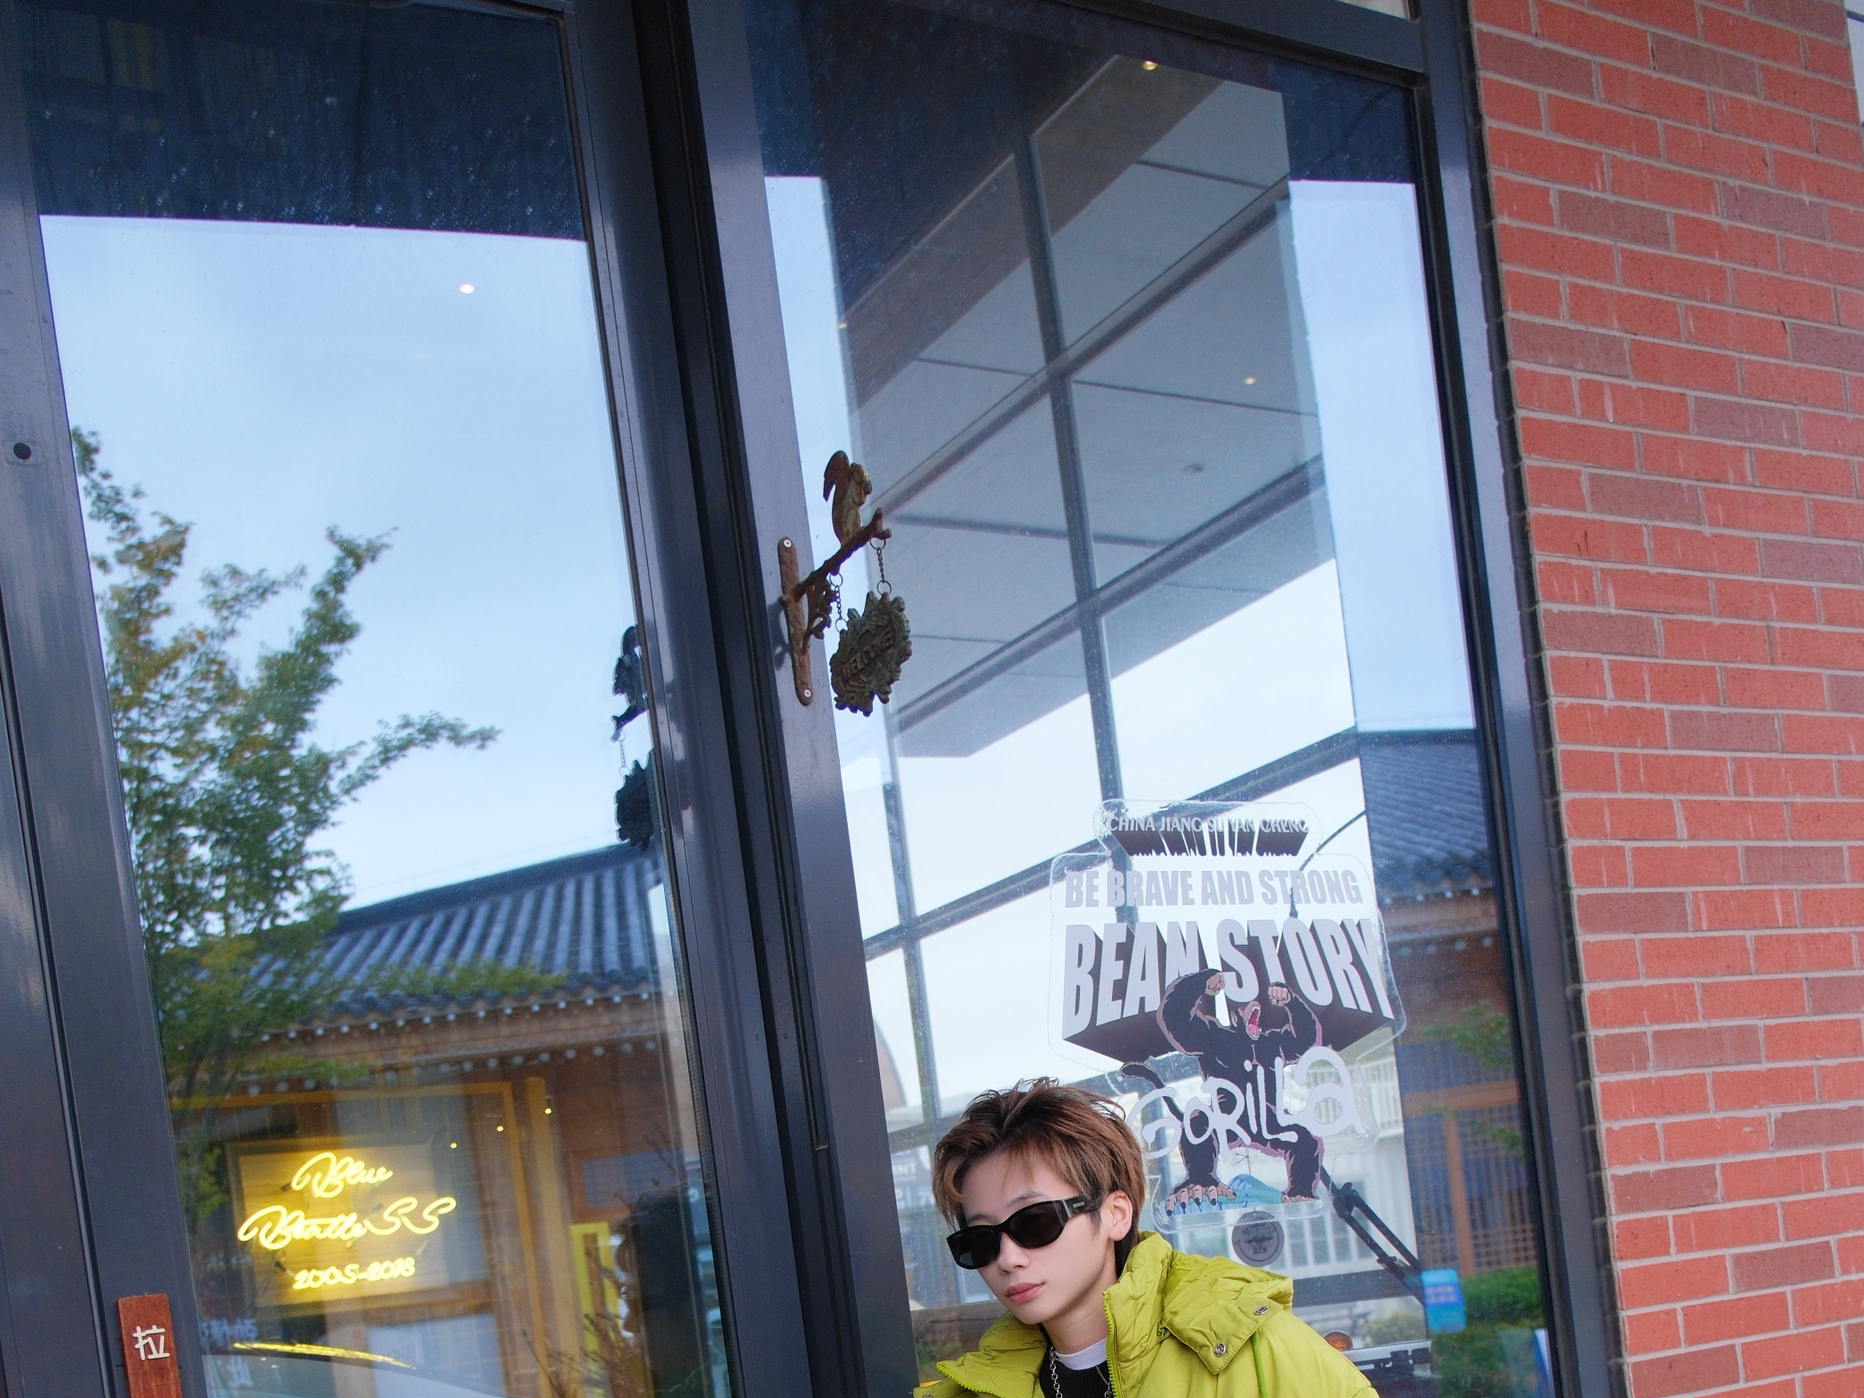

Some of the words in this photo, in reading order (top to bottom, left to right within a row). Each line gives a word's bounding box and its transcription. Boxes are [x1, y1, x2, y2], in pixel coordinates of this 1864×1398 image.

[1108, 816, 1155, 832] CHINA
[1159, 816, 1202, 832] JIANG
[1228, 818, 1256, 832] YAN
[1260, 818, 1310, 833] CHENG
[1064, 870, 1099, 909] BE
[1106, 870, 1195, 908] BRAVE
[1201, 870, 1255, 906] AND
[1261, 869, 1364, 905] STRONG
[1062, 920, 1200, 1040] BEAN
[1216, 918, 1395, 1020] STORY
[293, 1257, 415, 1289] 2005-2018
[133, 1325, 170, 1360] 拉
